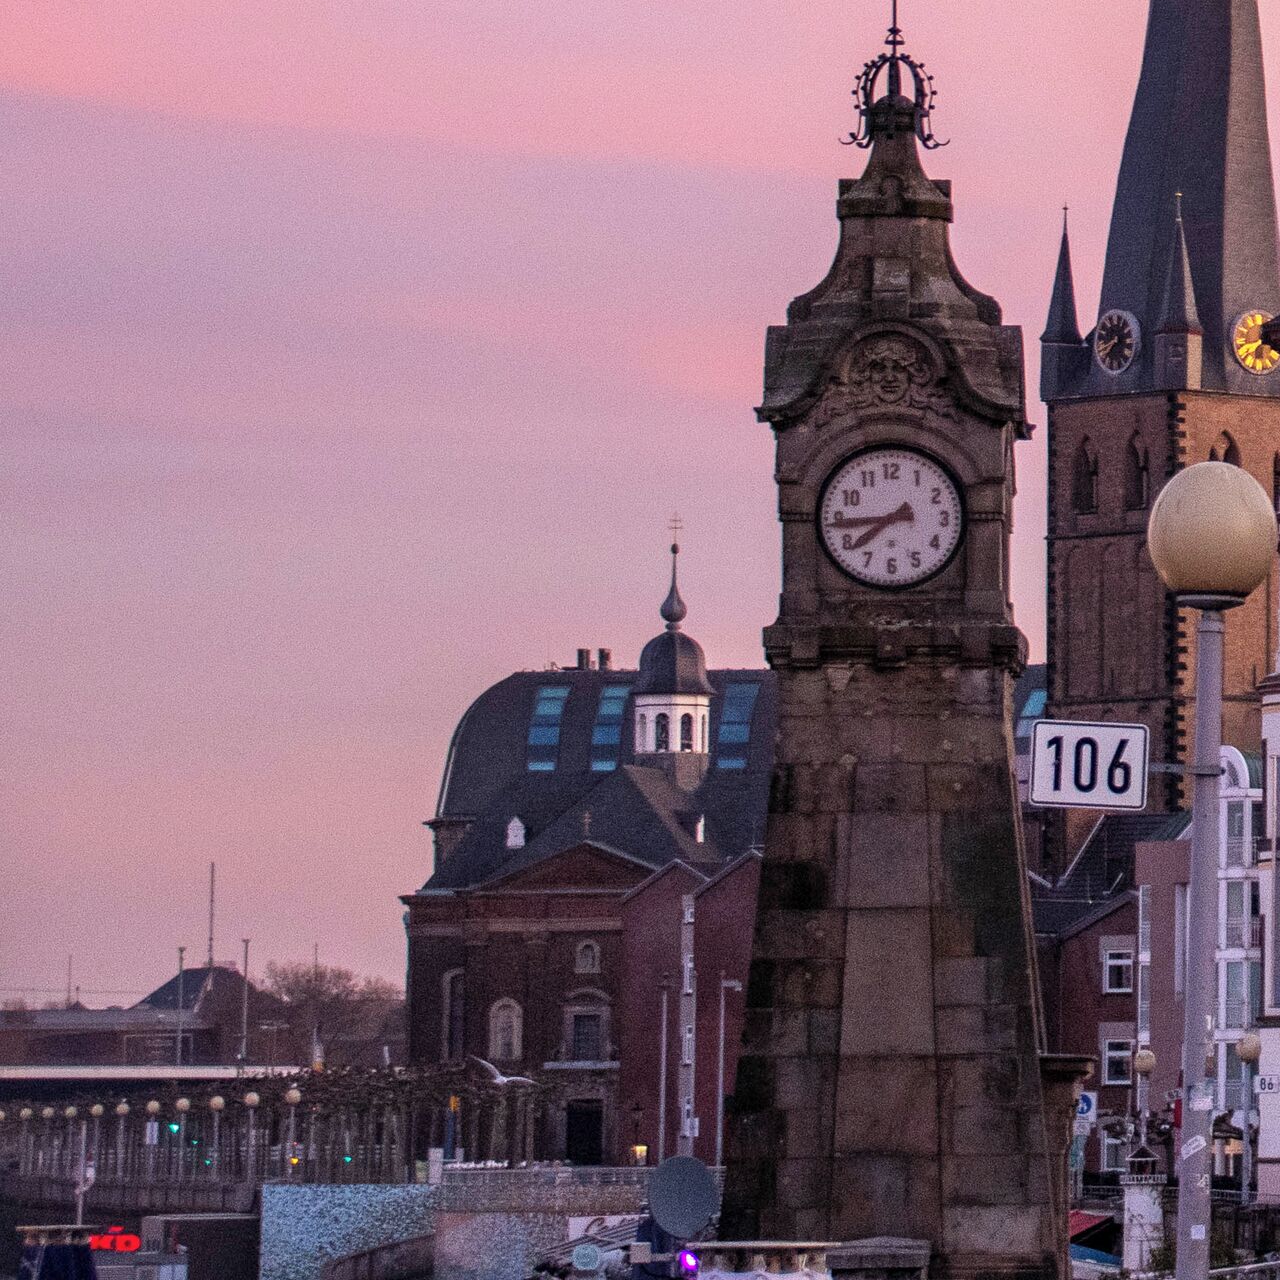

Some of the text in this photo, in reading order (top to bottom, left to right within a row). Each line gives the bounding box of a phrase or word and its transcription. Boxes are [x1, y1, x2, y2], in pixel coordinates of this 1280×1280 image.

[861, 470, 876, 487] 11
[882, 463, 900, 480] 12
[913, 470, 921, 487] 1
[842, 489, 861, 506] 10
[931, 488, 941, 504] 2
[940, 511, 949, 527] 3
[842, 534, 853, 550] 8
[930, 534, 940, 550] 4
[863, 551, 873, 568] 7
[887, 558, 896, 575] 6
[910, 552, 921, 568] 5
[1046, 735, 1131, 795] 106
[1260, 1077, 1274, 1090] 86
